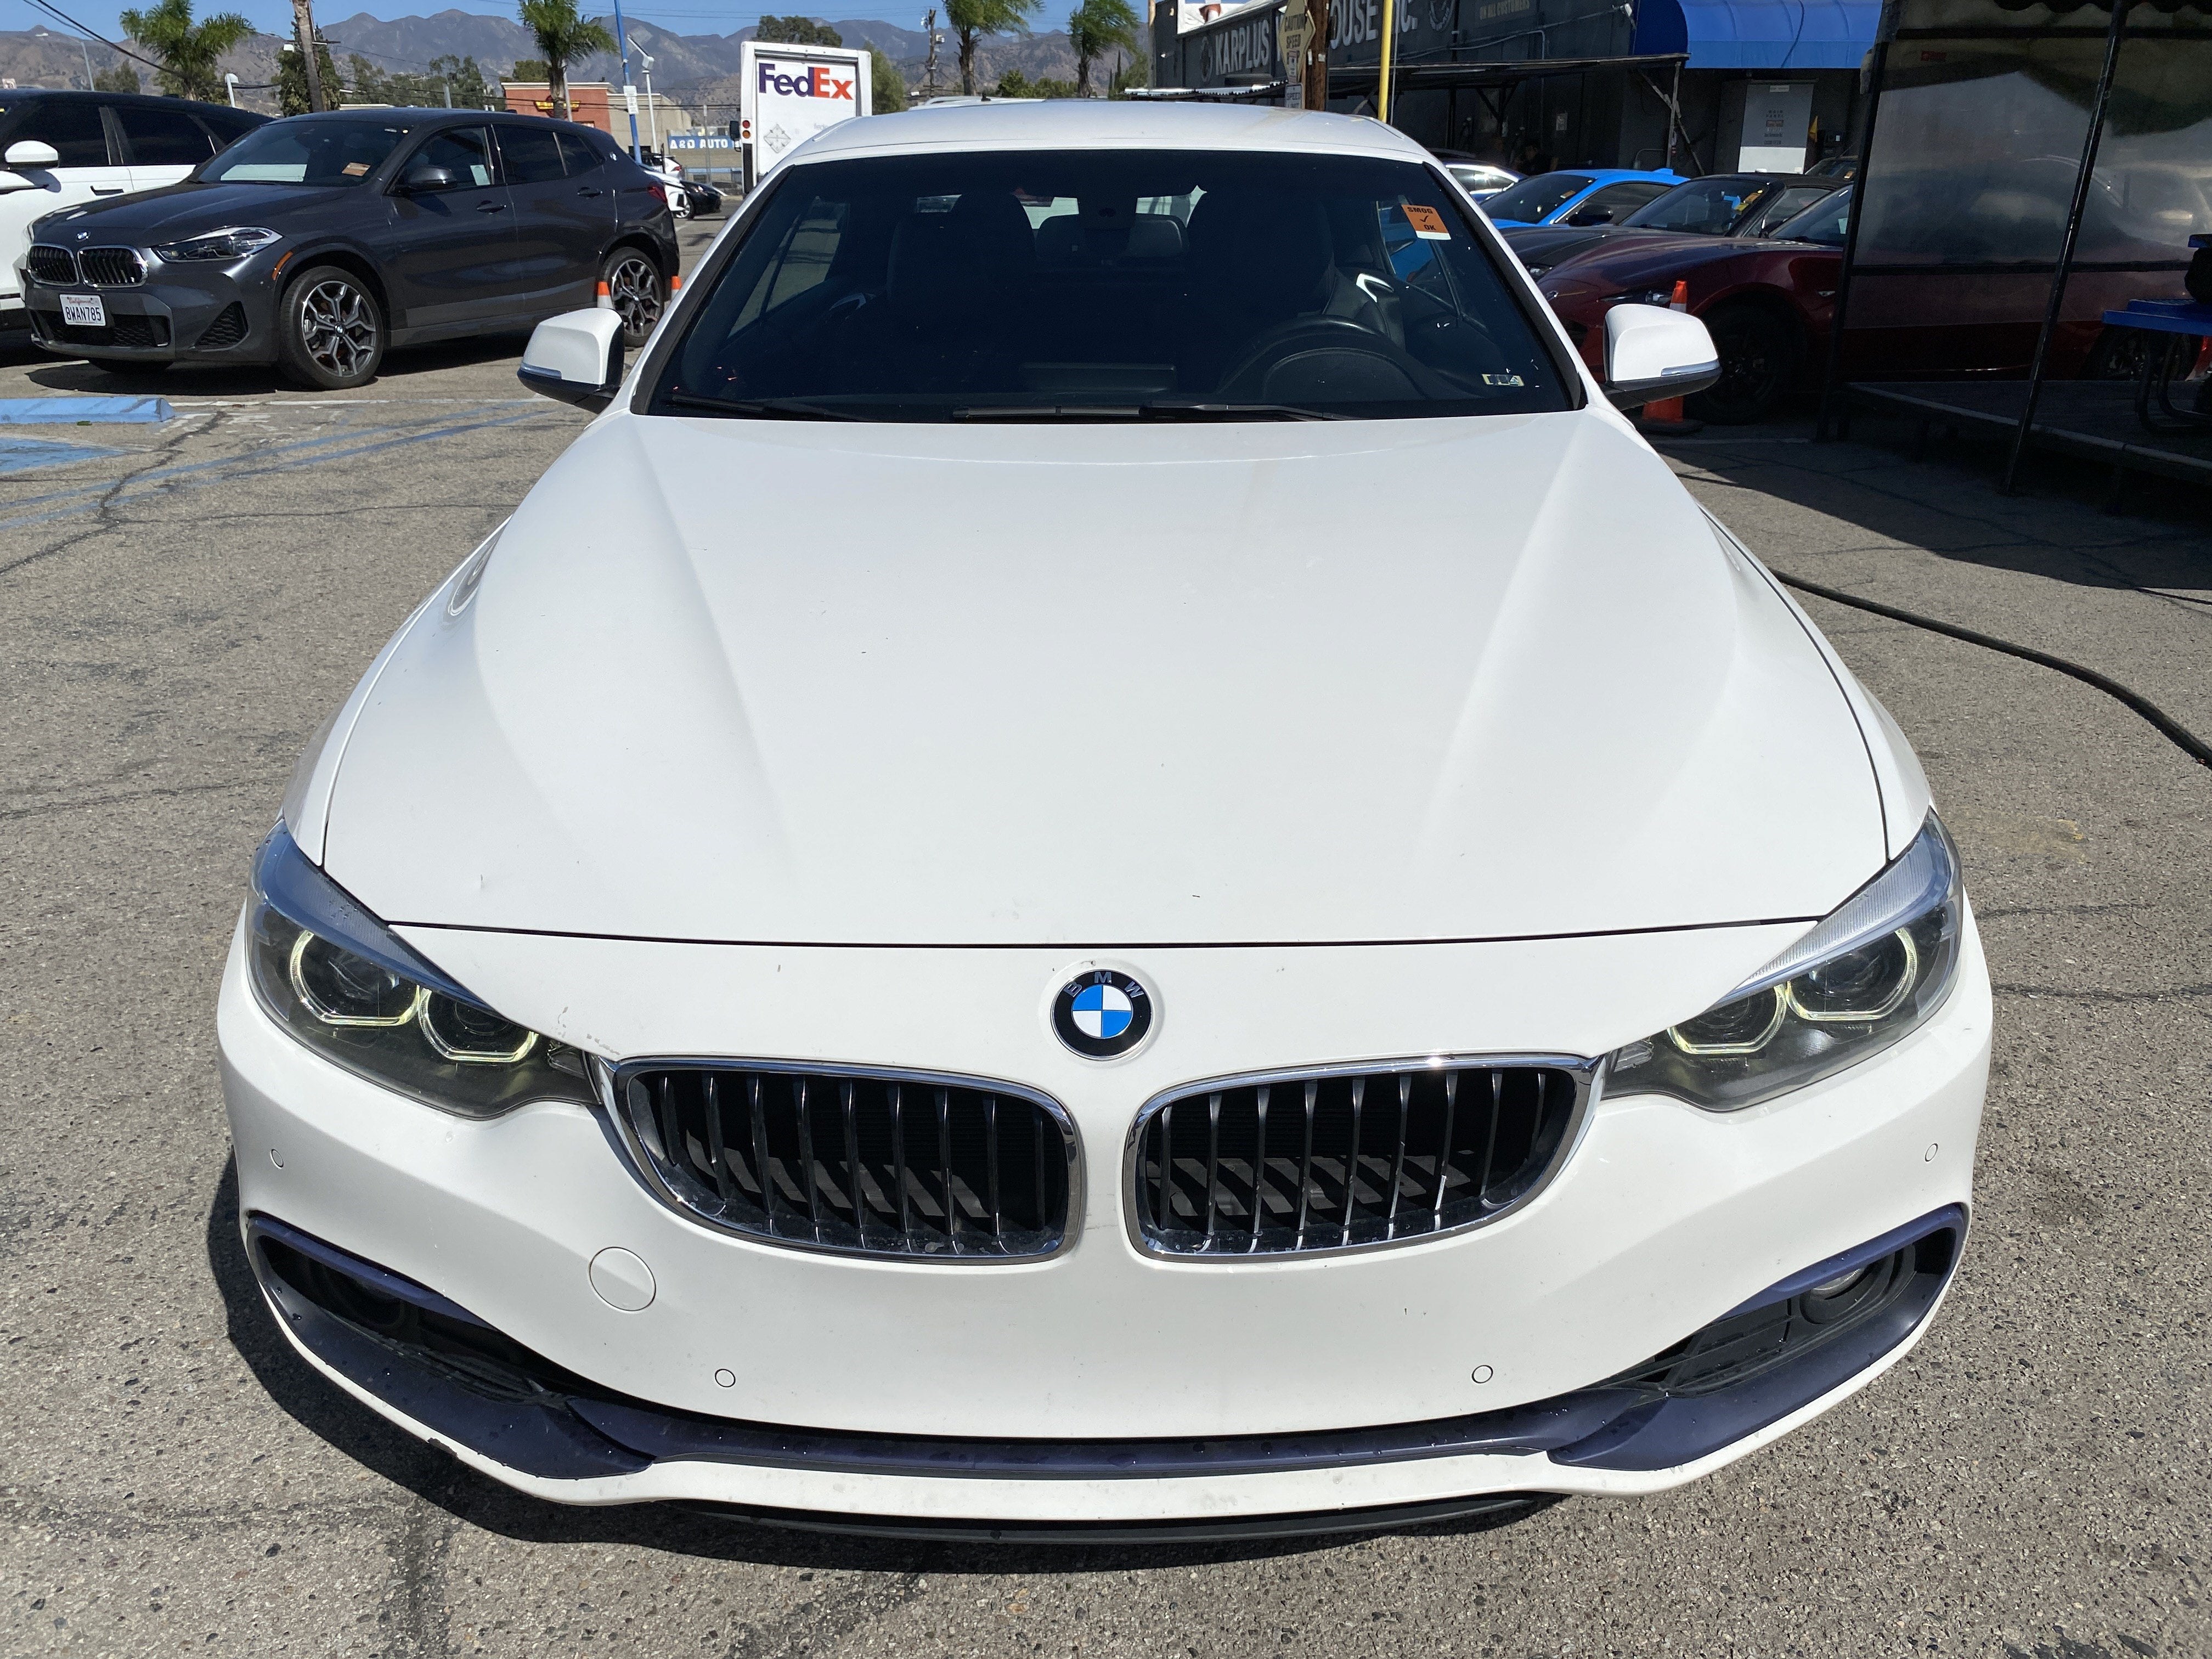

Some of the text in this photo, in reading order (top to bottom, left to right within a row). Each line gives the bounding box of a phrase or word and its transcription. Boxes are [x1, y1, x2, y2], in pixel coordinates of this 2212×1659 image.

[1215, 19, 1269, 76] KARPLUS
[759, 63, 854, 100] FedEx
[699, 138, 729, 149] AUTO
[65, 306, 101, 321] 8WAN785
[1063, 971, 1144, 998] BMW
